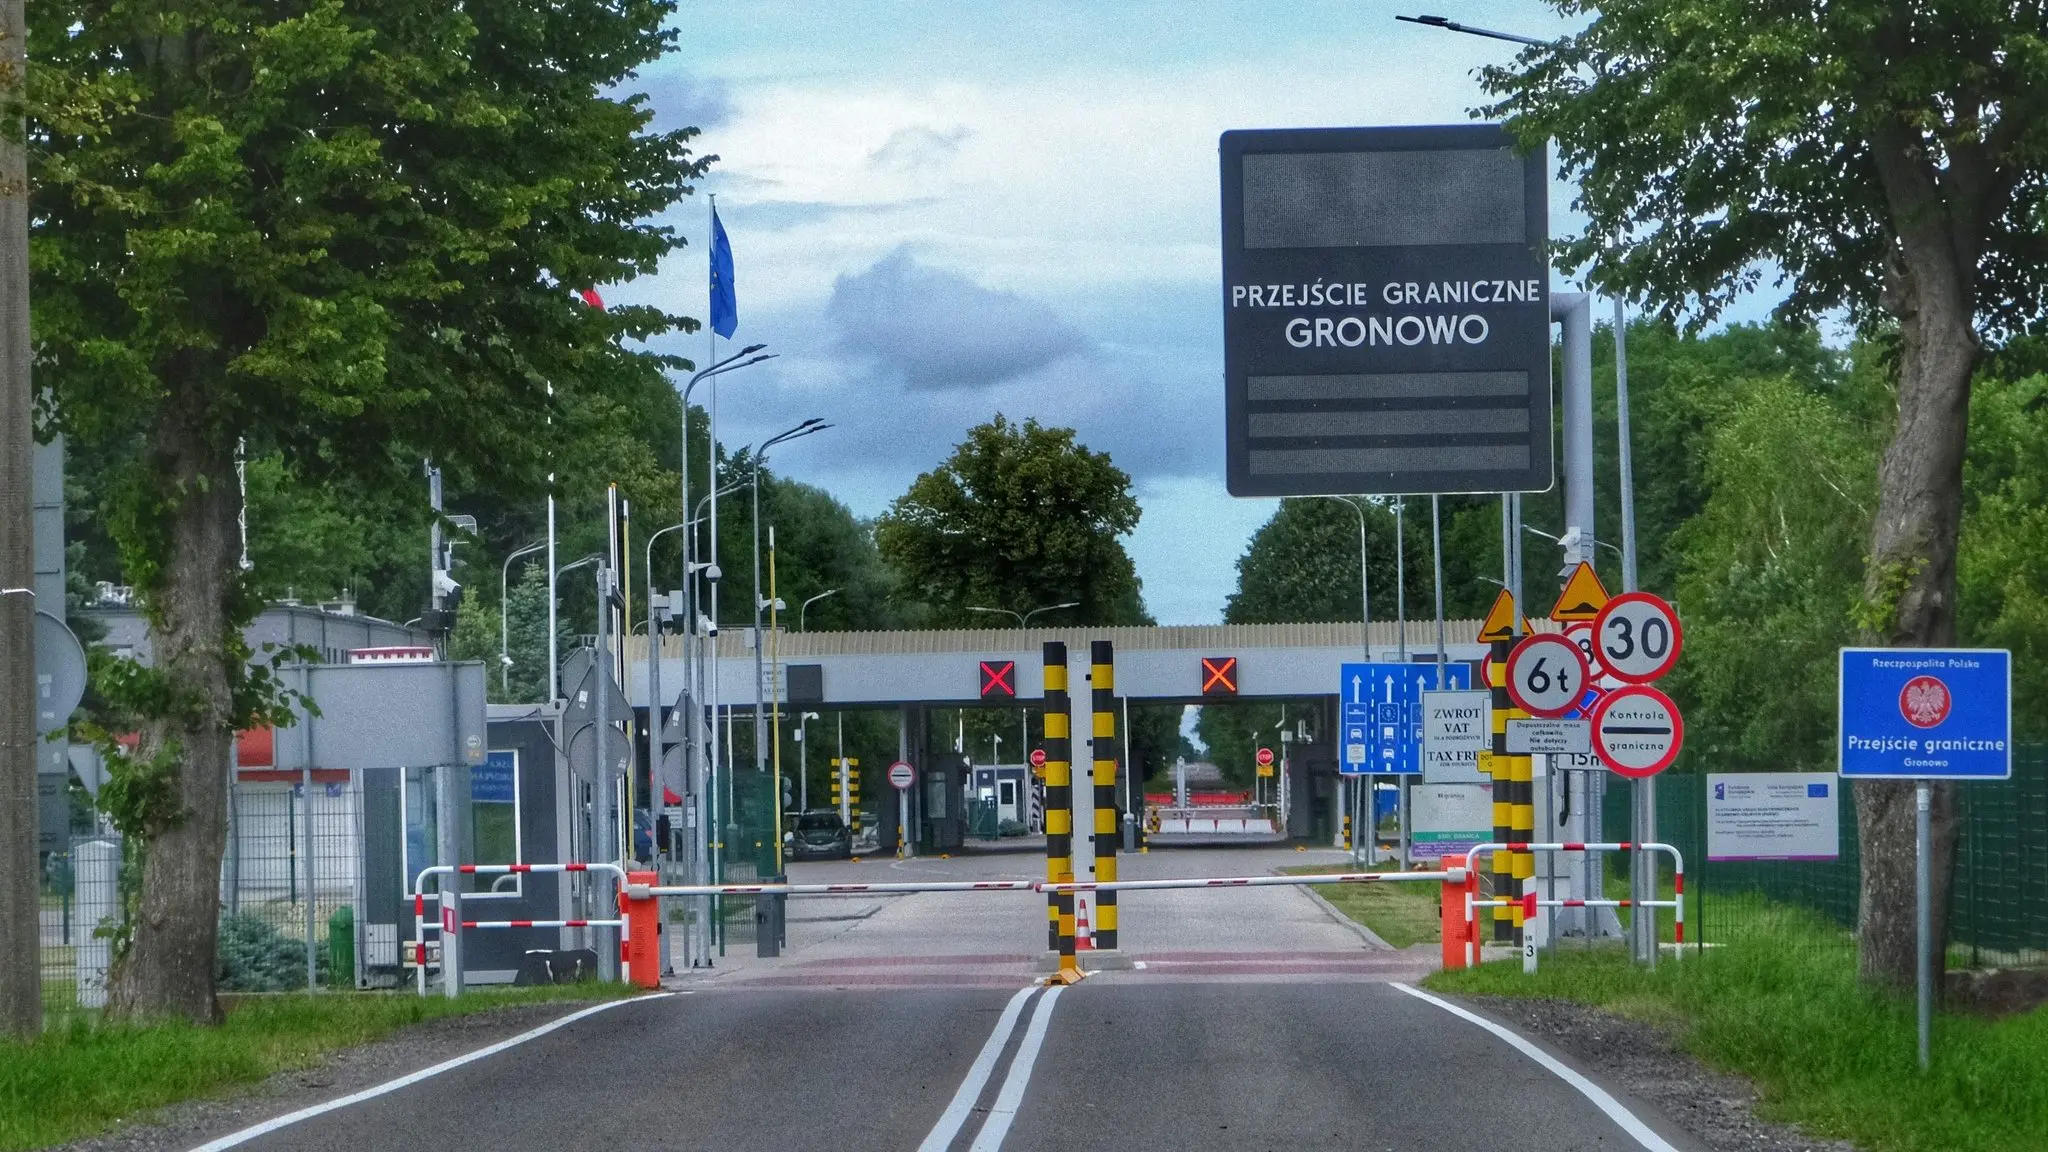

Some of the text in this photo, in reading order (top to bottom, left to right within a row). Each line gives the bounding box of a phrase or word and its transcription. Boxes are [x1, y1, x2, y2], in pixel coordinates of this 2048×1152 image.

[1232, 278, 1540, 307] PRZEJŚCIE GRANICZNE
[1285, 314, 1489, 348] GRONOWO
[1606, 616, 1669, 660] 30
[1872, 658, 1980, 670] Rzeczpospolita Polska
[1434, 708, 1481, 719] ZWROT
[1609, 710, 1664, 720] Kontrola
[1444, 723, 1471, 733] VAT
[1609, 742, 1664, 752] graniczna
[1848, 735, 2005, 754] Przejście graniczne
[1427, 750, 1453, 761] TAX
[1903, 757, 1949, 767] Gronowo
[1526, 944, 1534, 957] 3
